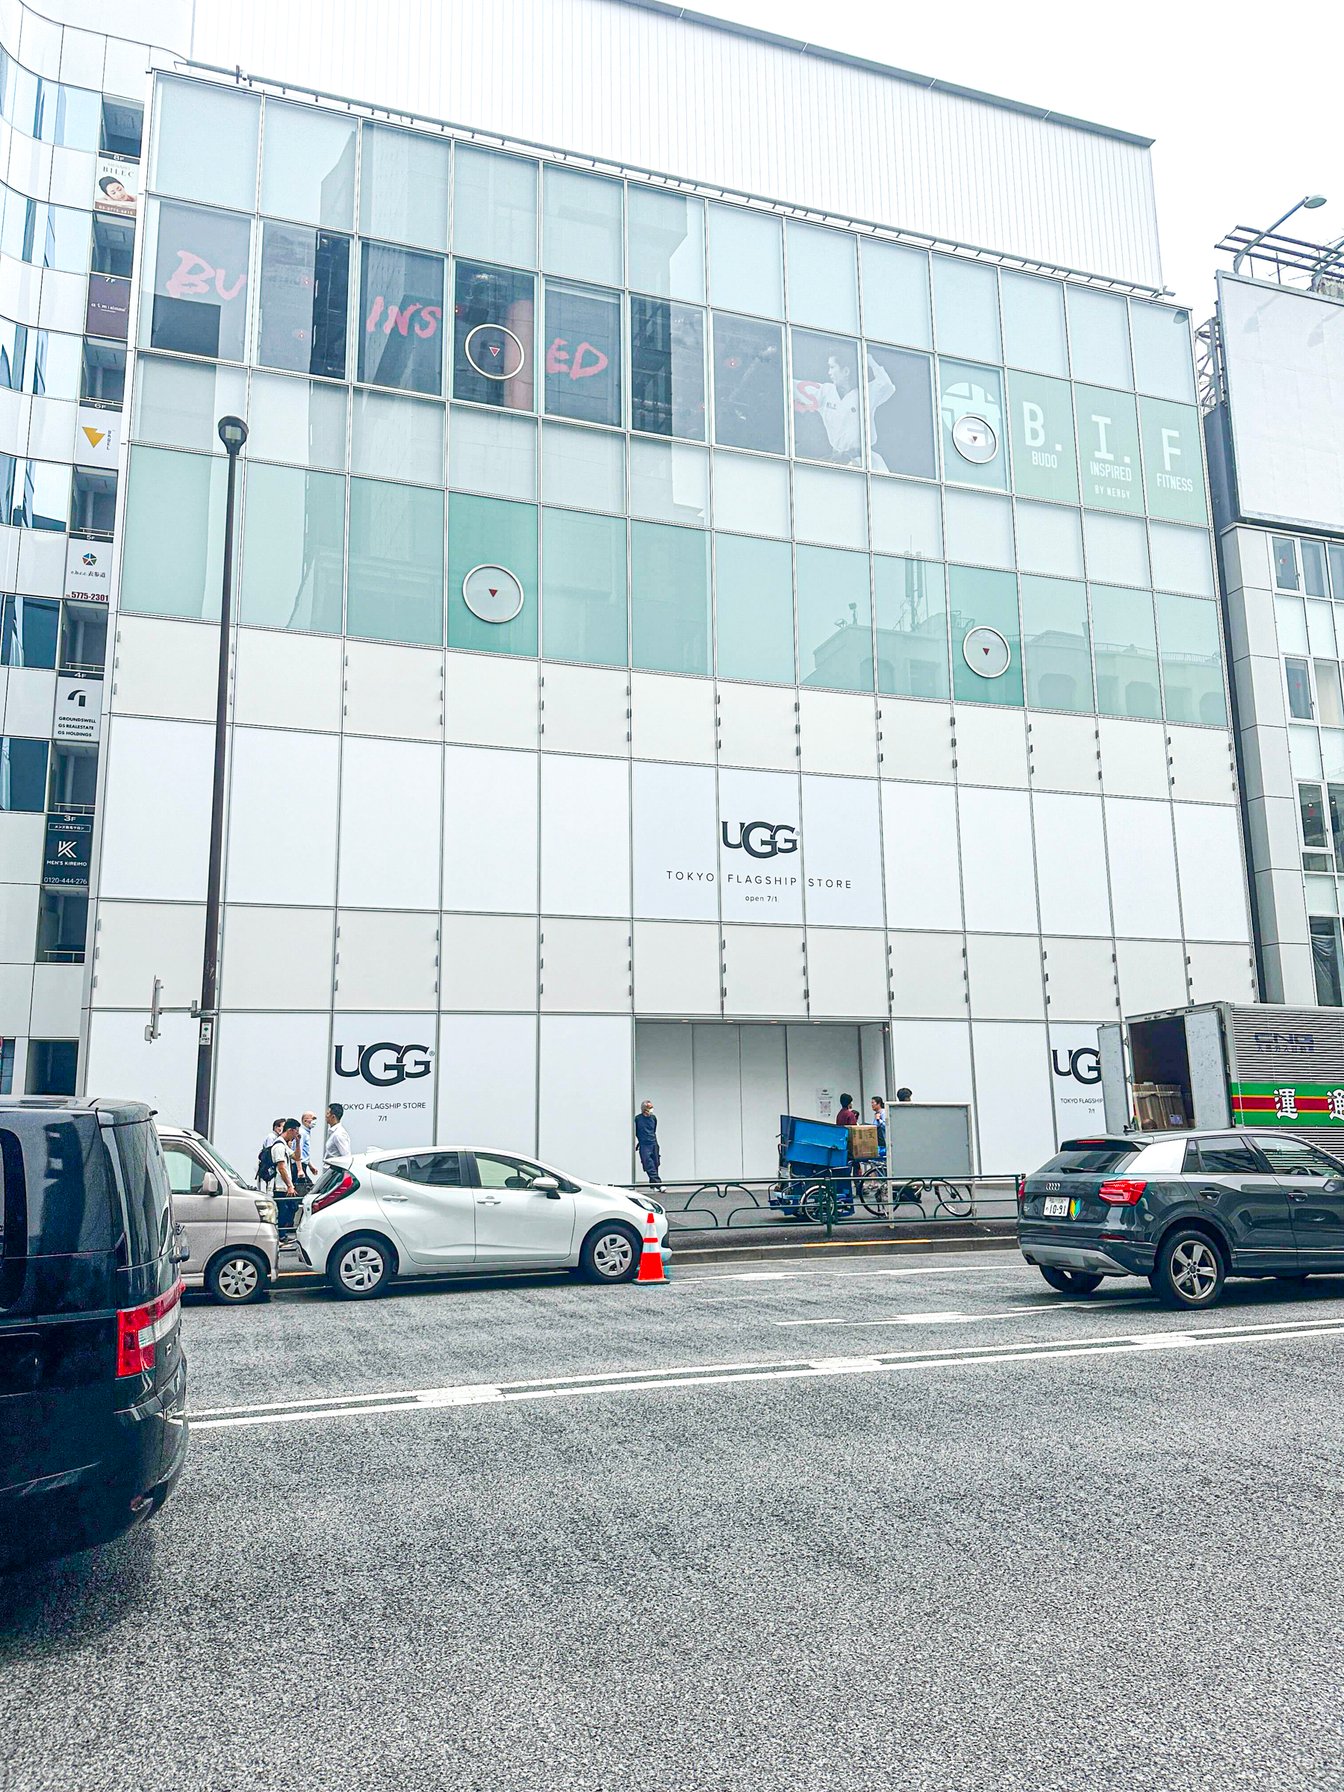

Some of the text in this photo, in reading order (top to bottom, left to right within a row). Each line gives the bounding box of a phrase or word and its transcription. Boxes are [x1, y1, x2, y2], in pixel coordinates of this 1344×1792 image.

[1161, 427, 1181, 472] F
[1032, 450, 1194, 492] BUDO INSPIRED FITNESS
[1095, 484, 1106, 495] BY
[71, 591, 109, 602] 5775-2301
[58, 716, 96, 724] GROUNDSWELL
[721, 821, 800, 859] UGG
[43, 876, 88, 885] 0120-444-276
[666, 870, 852, 889] TOKYO FLAGSHIP STORE
[745, 895, 778, 903] open 7/1
[334, 1041, 435, 1087] UGG
